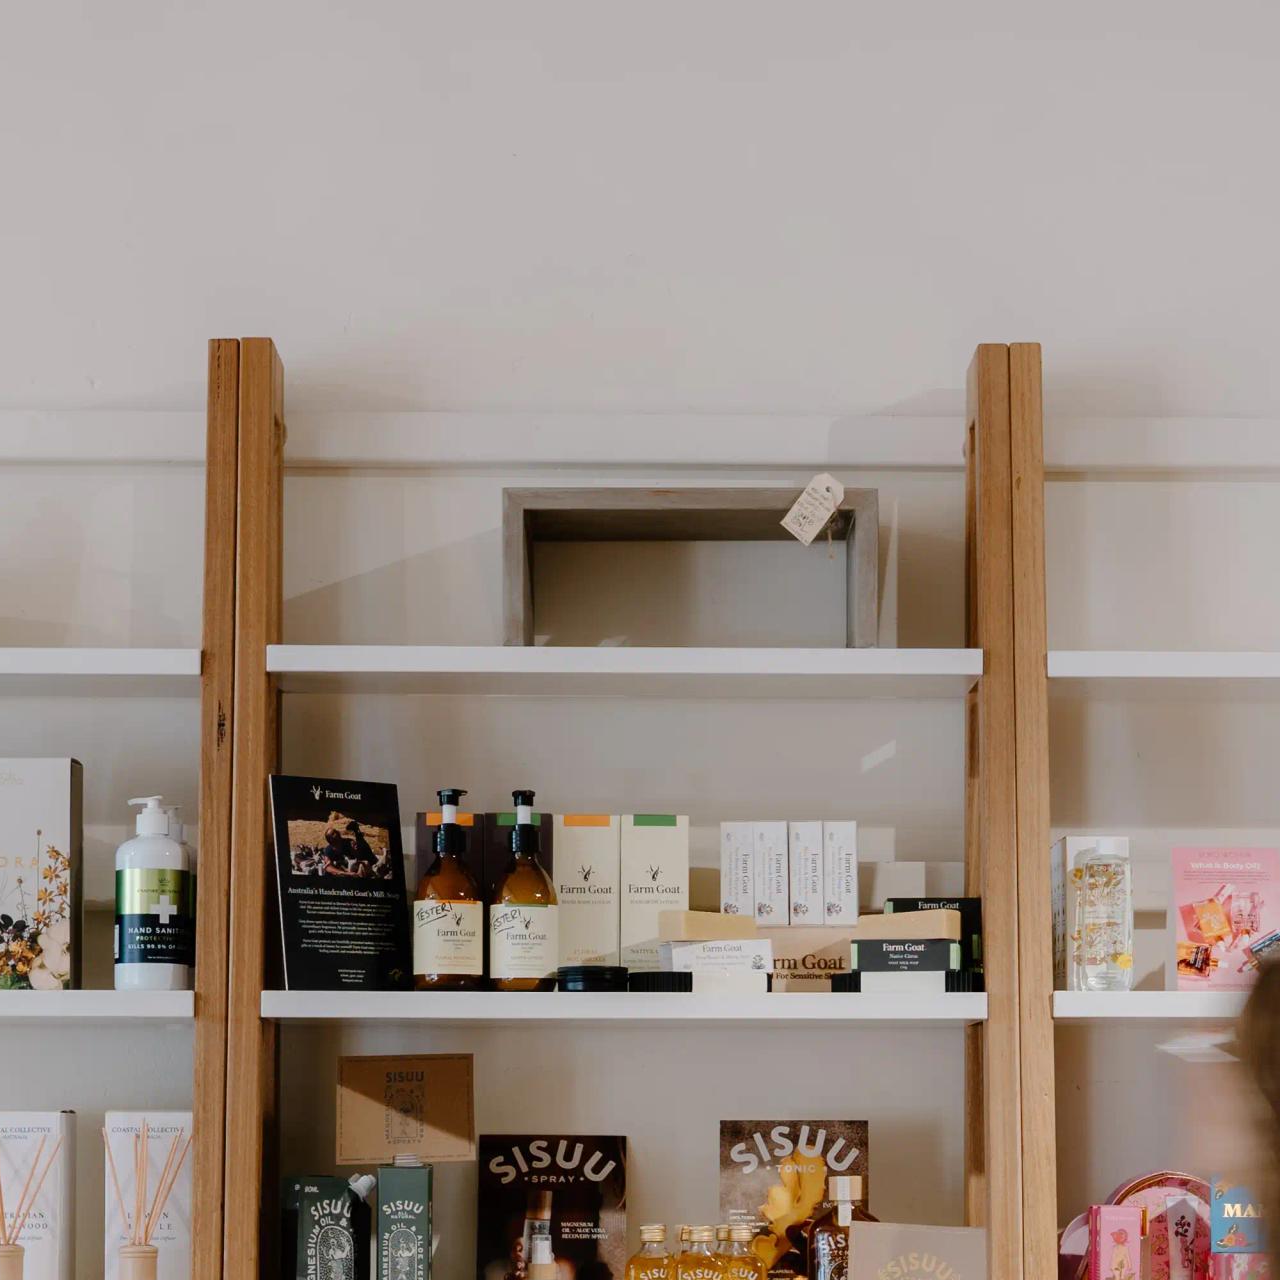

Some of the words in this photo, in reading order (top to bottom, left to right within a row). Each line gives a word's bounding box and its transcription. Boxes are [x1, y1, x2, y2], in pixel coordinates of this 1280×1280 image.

[325, 790, 344, 800] Farm
[344, 791, 361, 801] Goat
[319, 888, 353, 897] Handcrafted
[560, 884, 586, 894] Farm
[588, 884, 612, 894] Goat
[628, 884, 654, 894] Farm
[656, 884, 680, 894] Goat
[918, 901, 939, 910] Farm
[940, 901, 960, 910] Goat
[437, 929, 458, 937] Farm
[460, 929, 476, 937] Goat
[506, 932, 527, 940] Farm
[528, 932, 547, 940] Goat
[702, 944, 723, 953] Farm
[724, 944, 743, 953] Goat
[882, 943, 904, 952] Farm
[905, 943, 925, 952] Goat
[773, 957, 798, 970] rm
[802, 954, 845, 971] Goat
[384, 1071, 425, 1083] SISUU
[10, 1126, 51, 1134] COLLECTIVE
[145, 1126, 185, 1134] OLLECTIVE
[730, 1125, 860, 1174] SISUU
[489, 1139, 617, 1184] SISUU
[776, 1164, 816, 1173] TONIC
[531, 1175, 575, 1183] SPRAY
[310, 1199, 353, 1221] SISUU
[382, 1200, 424, 1215] SISUU
[320, 1216, 335, 1228] OIL
[339, 1217, 348, 1227] &
[391, 1222, 406, 1231] OIL
[416, 1234, 424, 1260] ALOE
